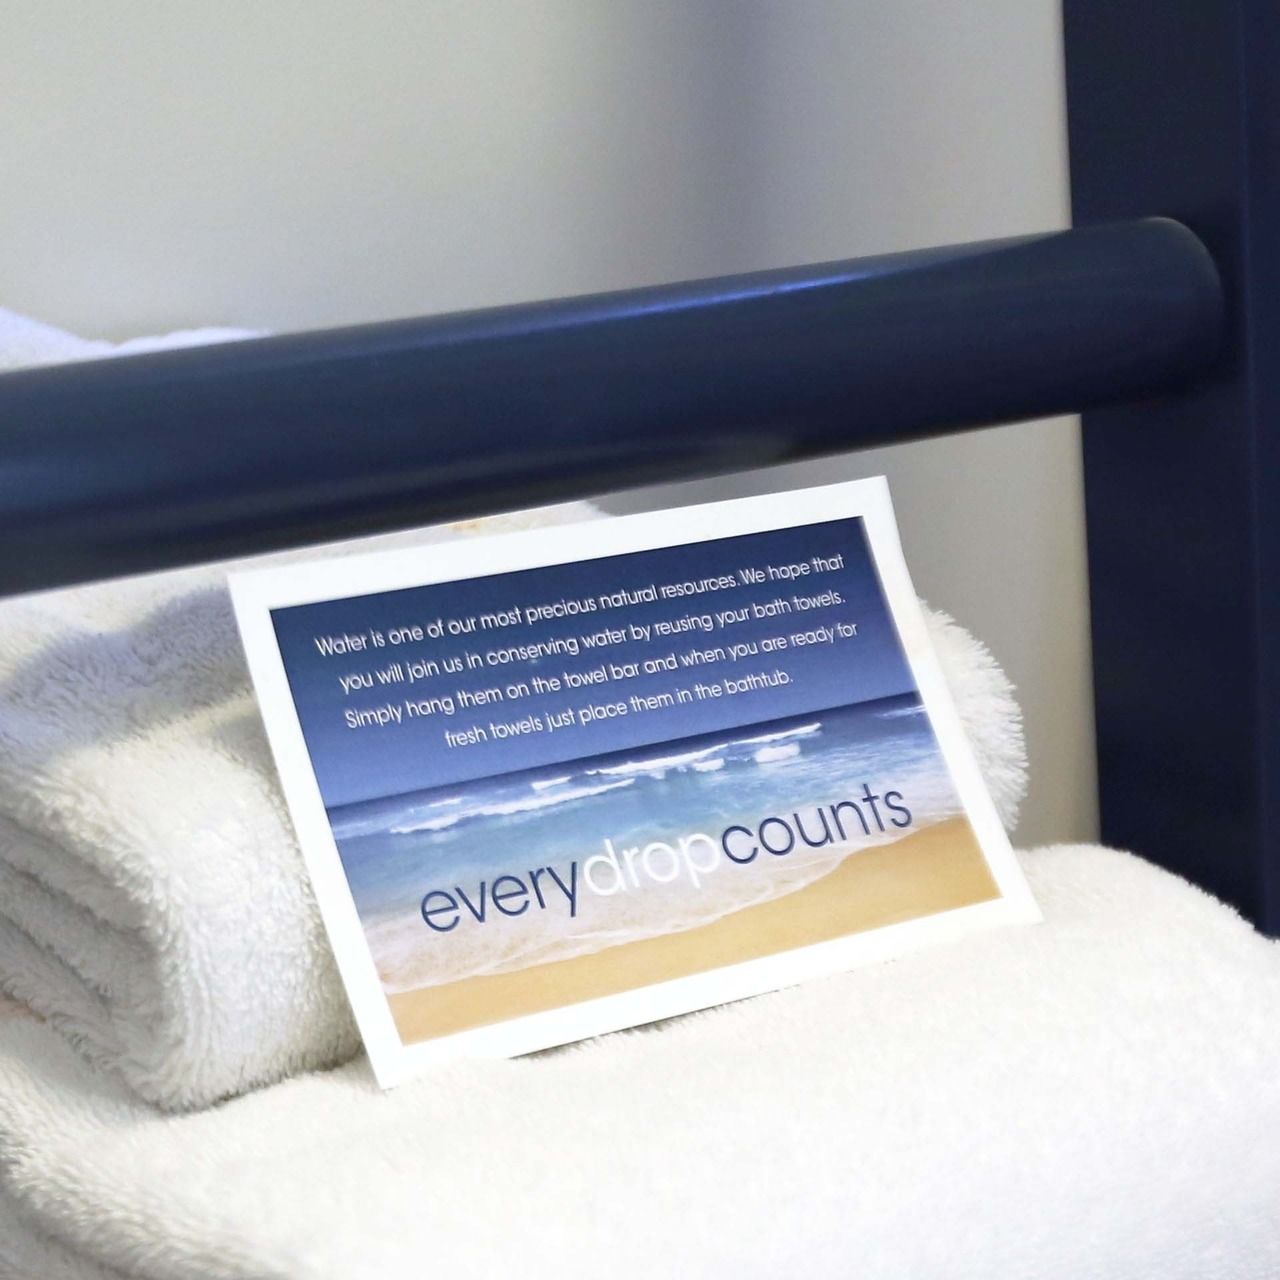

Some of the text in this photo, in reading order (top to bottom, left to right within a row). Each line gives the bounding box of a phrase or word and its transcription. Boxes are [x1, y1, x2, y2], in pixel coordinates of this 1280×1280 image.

[315, 554, 845, 657] Water is one of our most precious natural resources. We hope that
[340, 590, 846, 696] you will join us in conserving water by reusing your bath towels.
[346, 623, 858, 729] Simply hang them on the towel bar and when you are ready for
[446, 670, 794, 749] fresh towels just place them in the bathtub.
